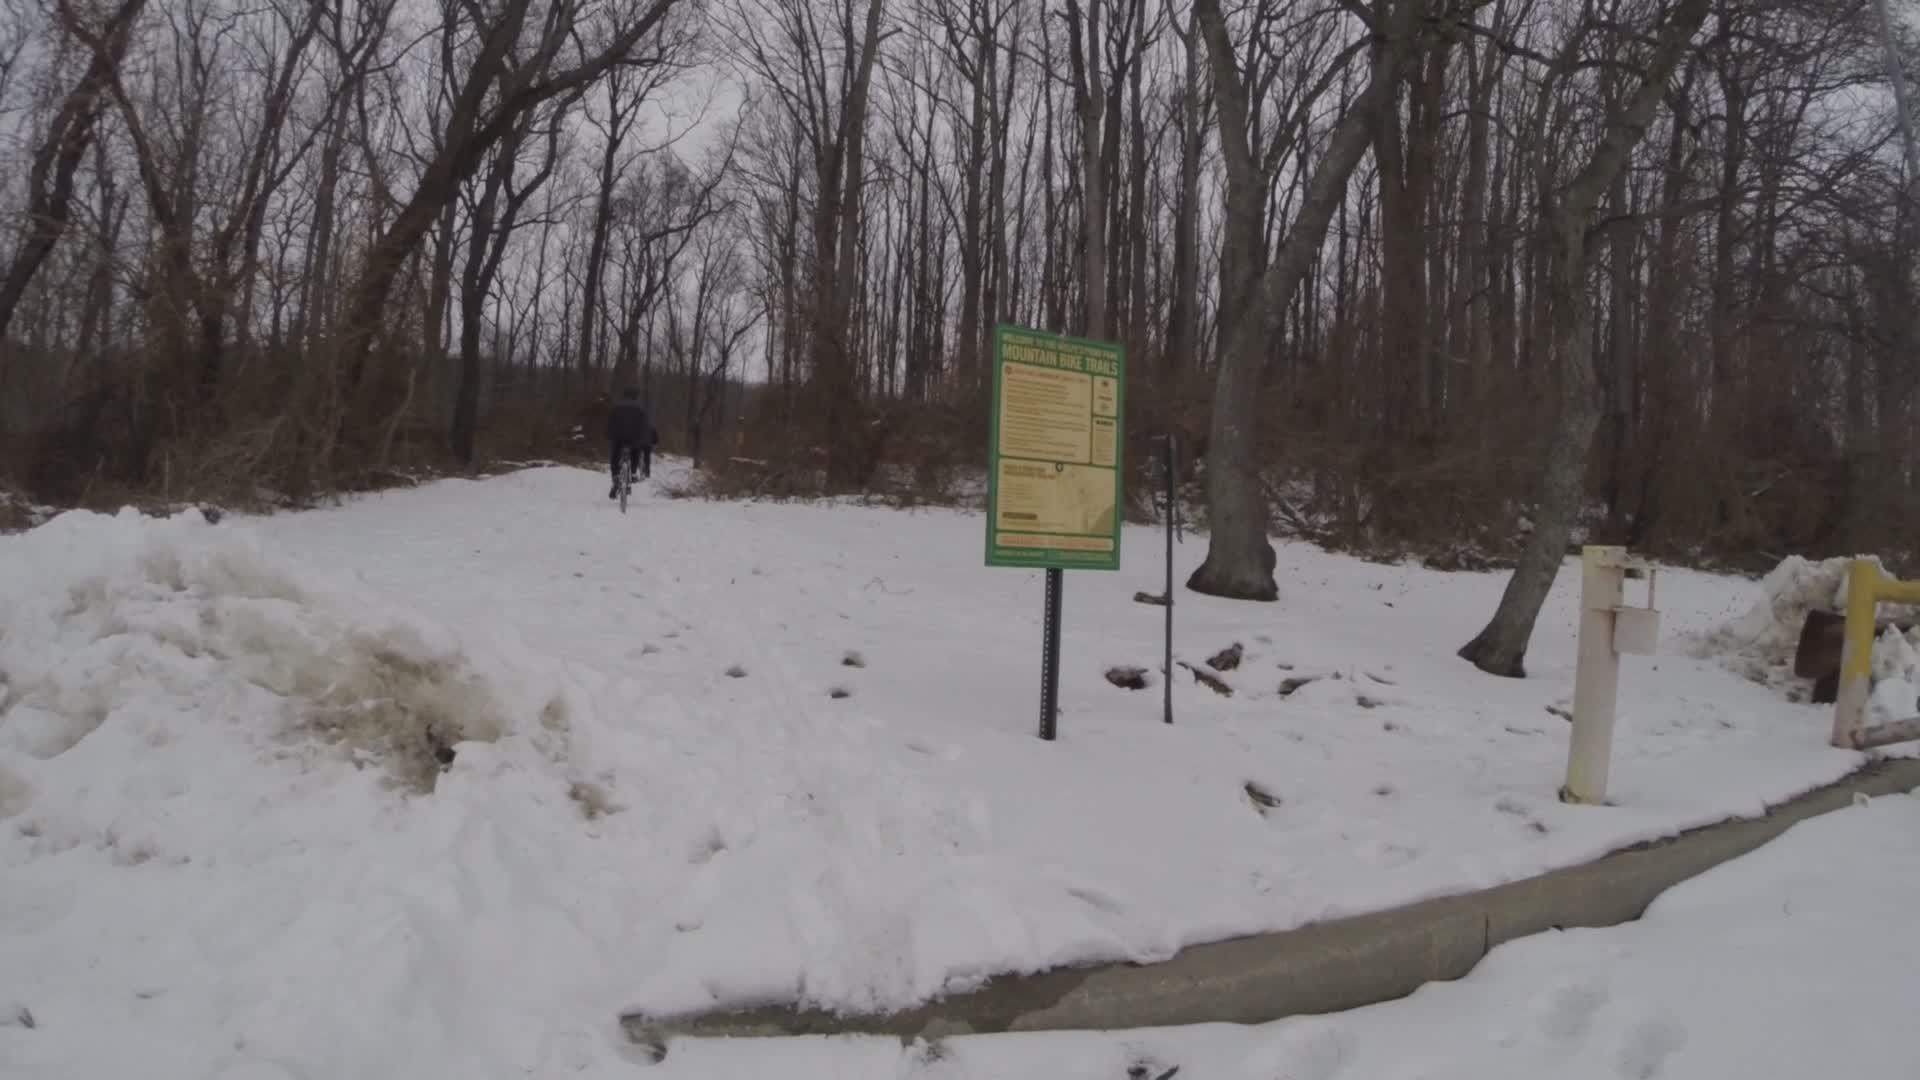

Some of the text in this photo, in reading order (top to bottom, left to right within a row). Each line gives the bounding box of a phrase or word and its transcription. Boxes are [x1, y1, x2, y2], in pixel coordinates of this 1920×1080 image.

[1002, 343, 1057, 366] MOUNTAIN
[1059, 351, 1084, 370] BIKE
[1086, 357, 1119, 376] TRAILS
